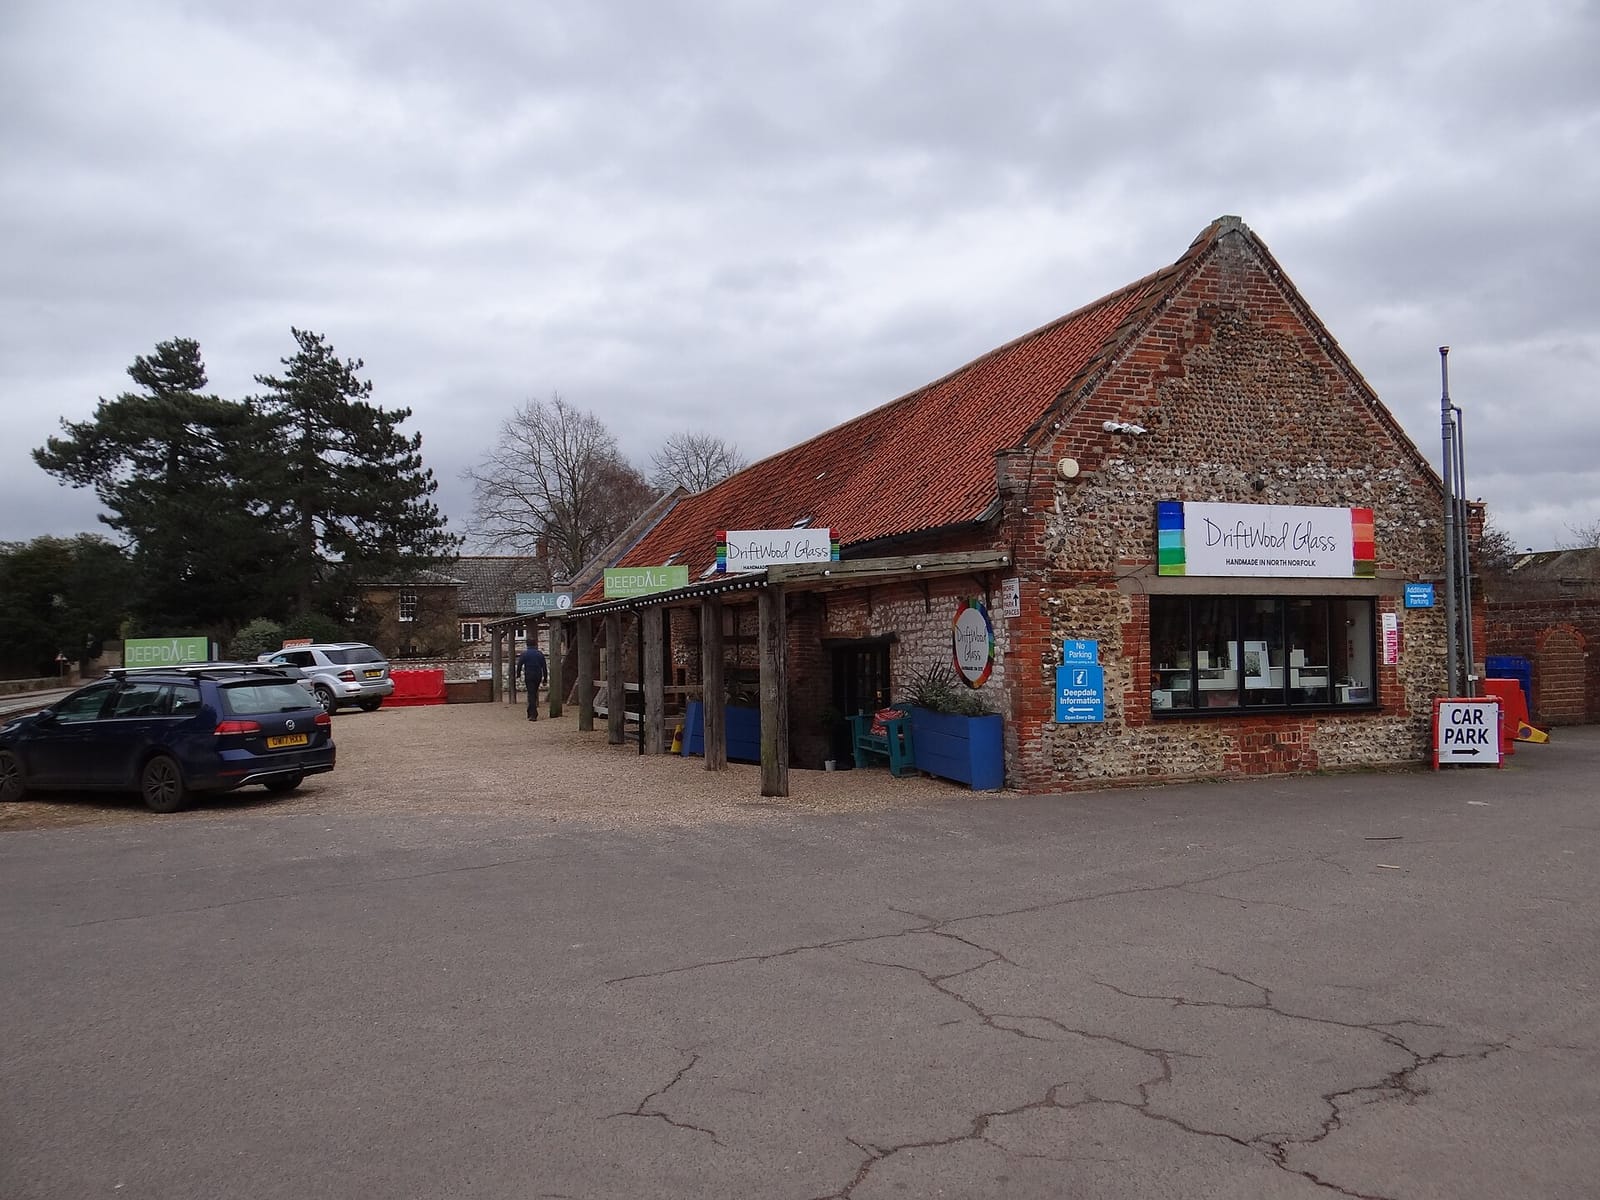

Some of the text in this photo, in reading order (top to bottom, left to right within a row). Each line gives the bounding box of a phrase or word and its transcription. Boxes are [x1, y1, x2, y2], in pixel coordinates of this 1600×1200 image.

[1203, 517, 1337, 553] DriftWood Glass
[728, 539, 829, 560] DriftWood Glass
[1225, 558, 1317, 567] HANDMADE IN NORTH NORFOLK
[606, 570, 668, 589] DEEPDALE
[1406, 586, 1432, 594] Additional
[517, 595, 555, 607] DEEPDALE
[1410, 598, 1429, 606] Parking
[126, 639, 197, 662] DEEPDALE
[1075, 642, 1086, 650] No
[1068, 650, 1093, 660] Parking
[1063, 688, 1097, 698] Deepdale
[1060, 696, 1101, 705] Information
[1451, 708, 1484, 725] CAR
[1444, 728, 1489, 744] PARK
